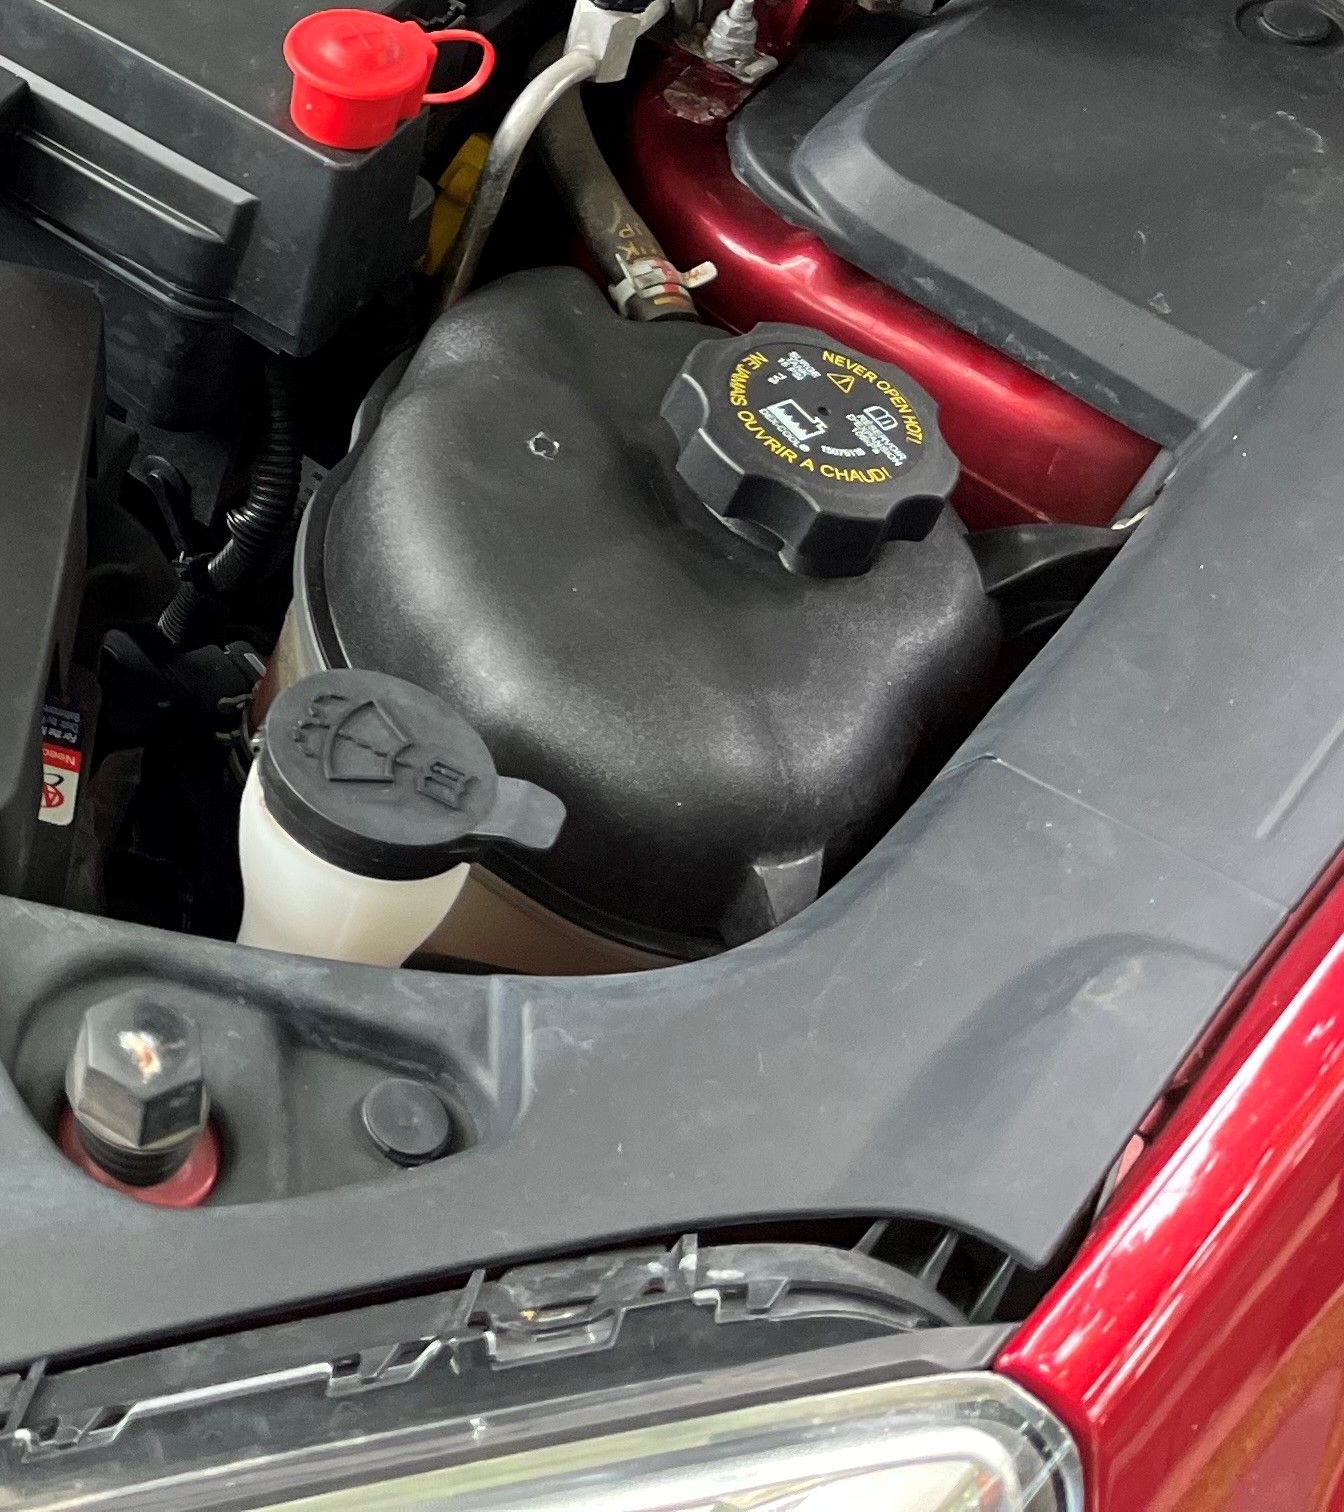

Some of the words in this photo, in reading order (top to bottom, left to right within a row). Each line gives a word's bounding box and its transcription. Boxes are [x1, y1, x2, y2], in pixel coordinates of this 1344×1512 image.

[741, 351, 769, 370] NE
[728, 363, 752, 407] JAMAIS
[822, 350, 876, 383] NEVER
[877, 380, 912, 415] OPEN
[901, 414, 924, 445] HOT!
[737, 410, 799, 464] OUVRIR
[799, 458, 815, 472] A
[819, 464, 892, 485] CHAUD!
